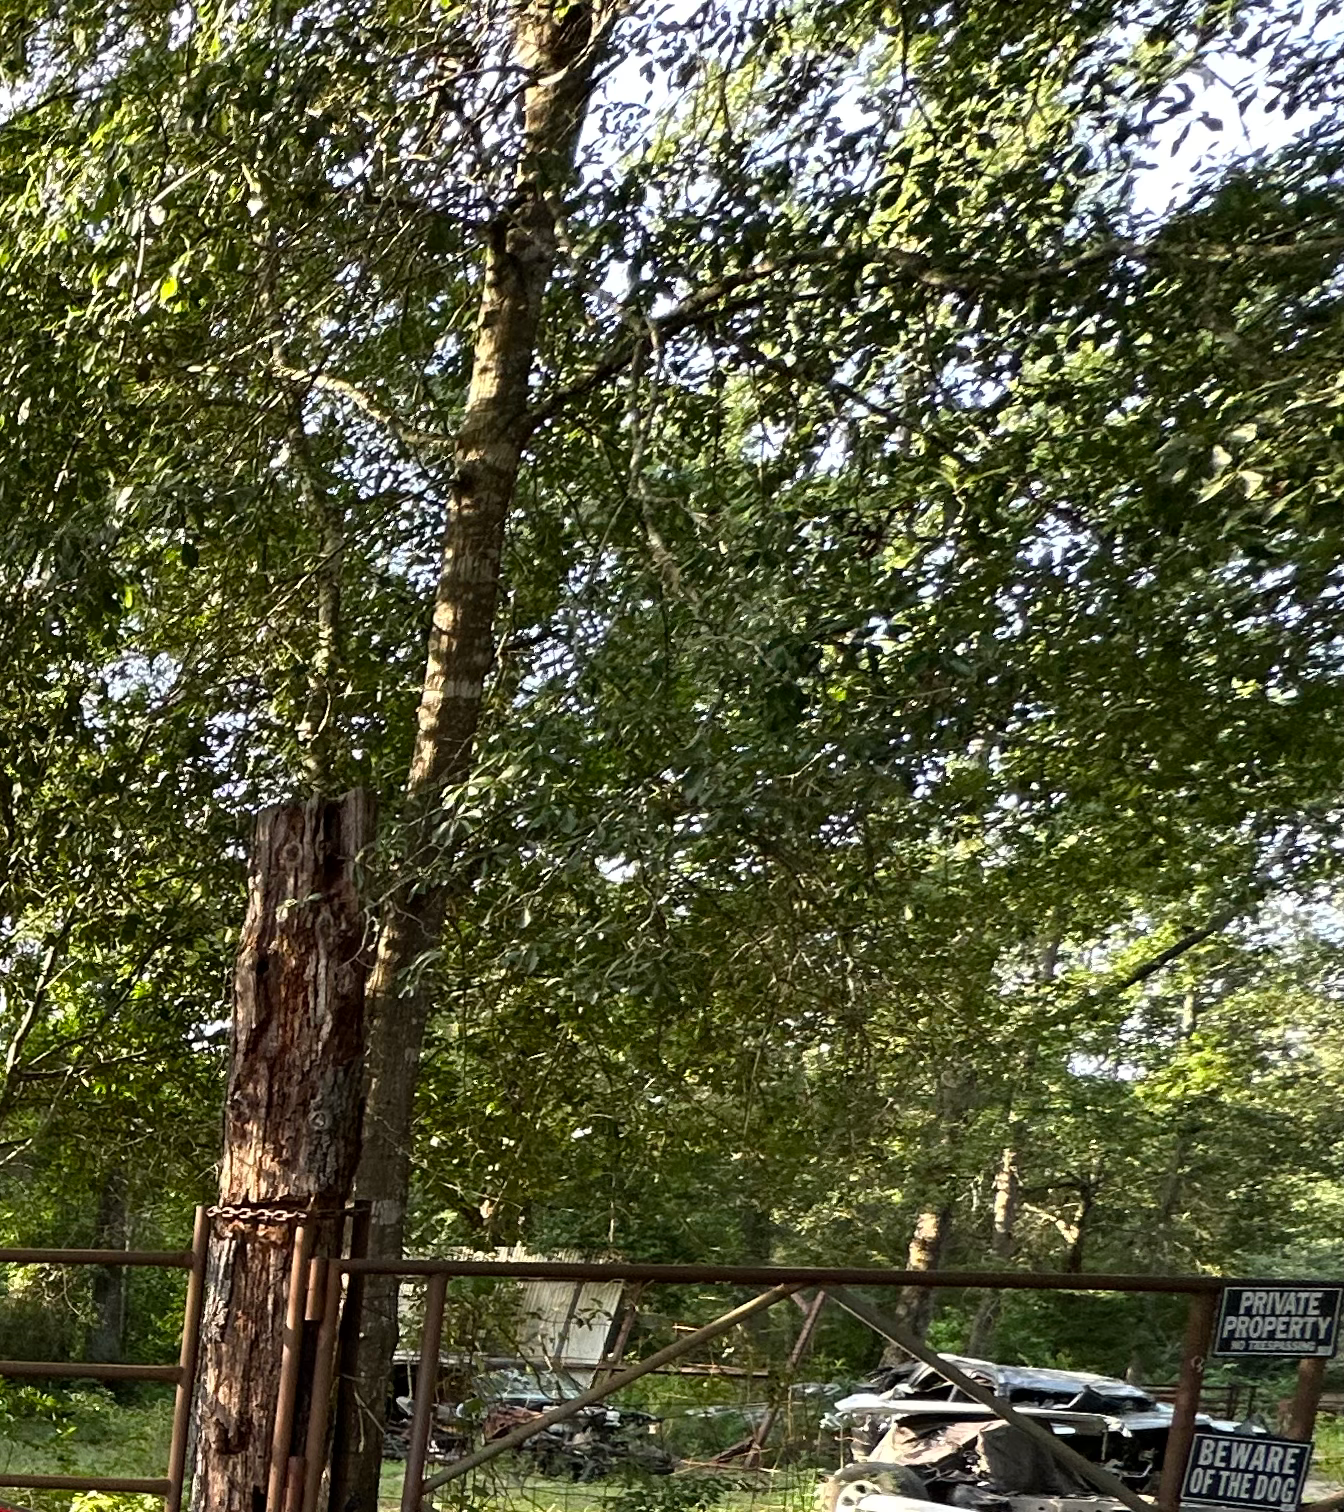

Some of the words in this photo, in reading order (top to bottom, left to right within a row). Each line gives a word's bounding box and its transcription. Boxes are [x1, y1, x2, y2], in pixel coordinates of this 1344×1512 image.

[1239, 1291, 1324, 1315] PRIVATE
[1222, 1316, 1331, 1339] PROPERTY
[1197, 1439, 1301, 1475] BEWARE
[1189, 1467, 1217, 1495] OF
[1217, 1470, 1251, 1499] THE
[1252, 1474, 1297, 1503] DOG
